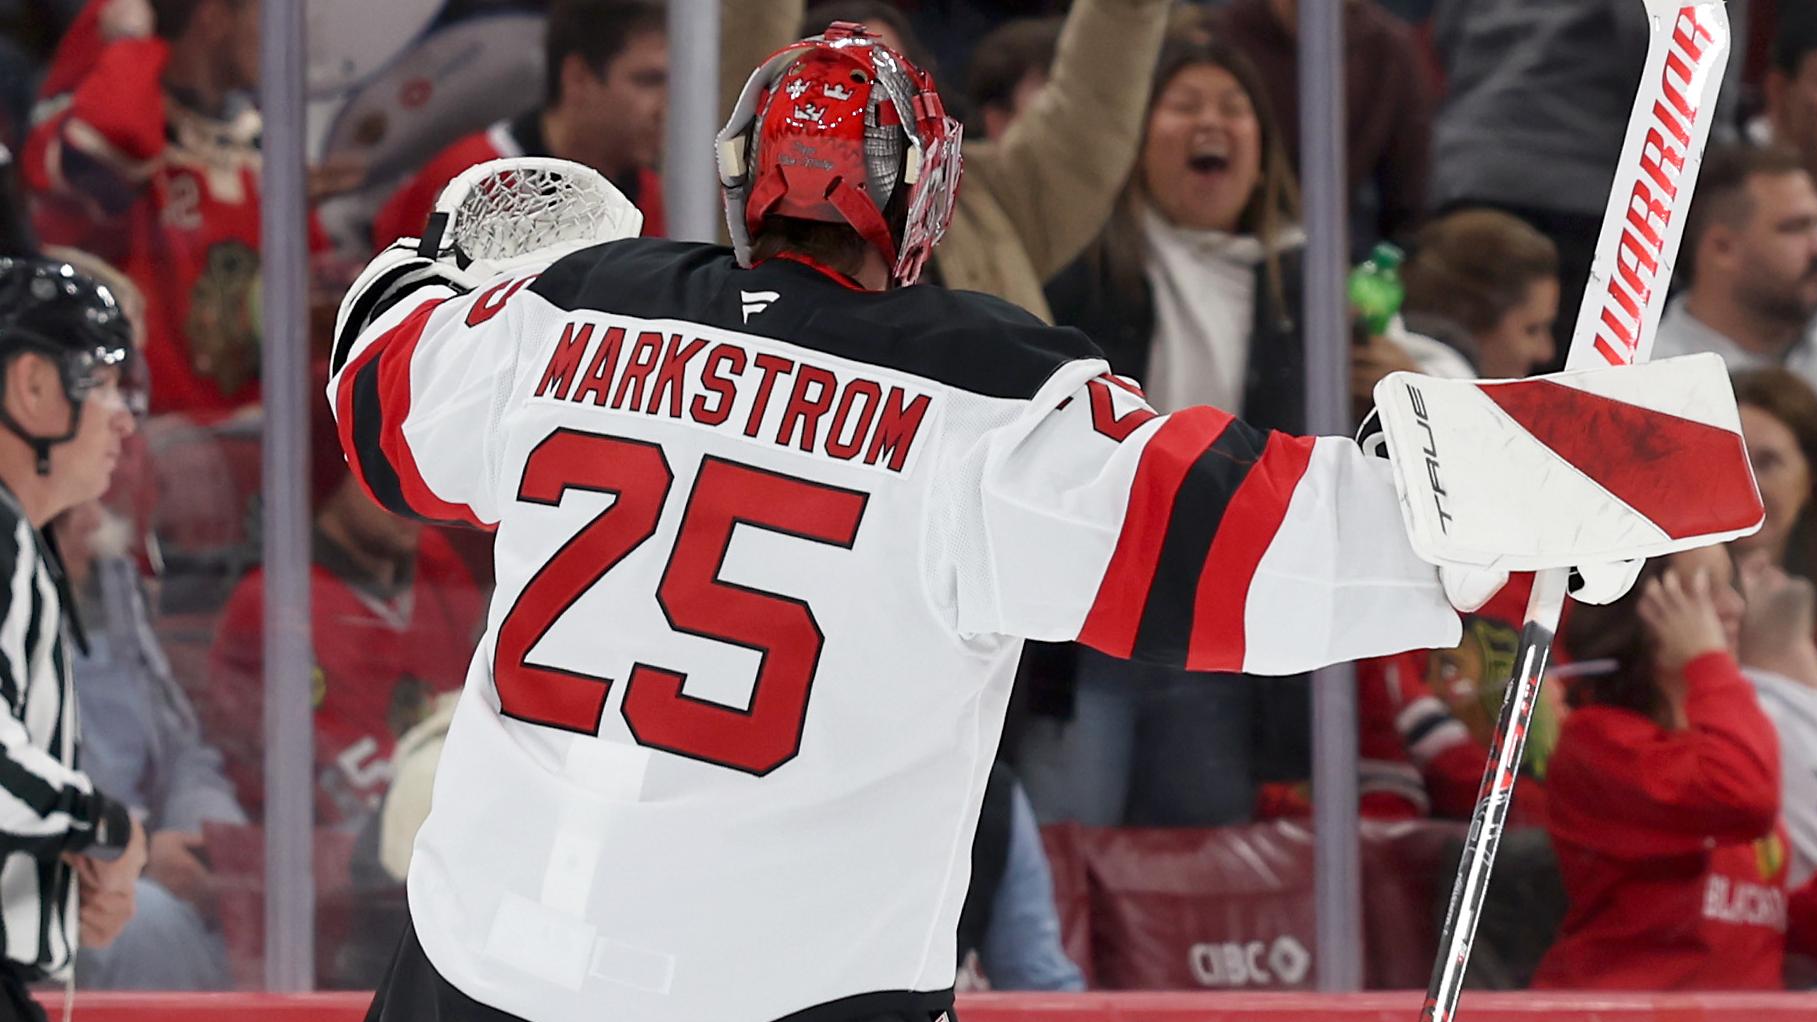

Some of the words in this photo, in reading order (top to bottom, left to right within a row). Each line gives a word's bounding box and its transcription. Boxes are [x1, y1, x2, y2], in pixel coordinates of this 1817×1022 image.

[1593, 5, 1714, 366] WARRIOR
[533, 321, 932, 473] MARKSTROM
[1405, 383, 1454, 536] TRUE
[492, 426, 868, 778] 25
